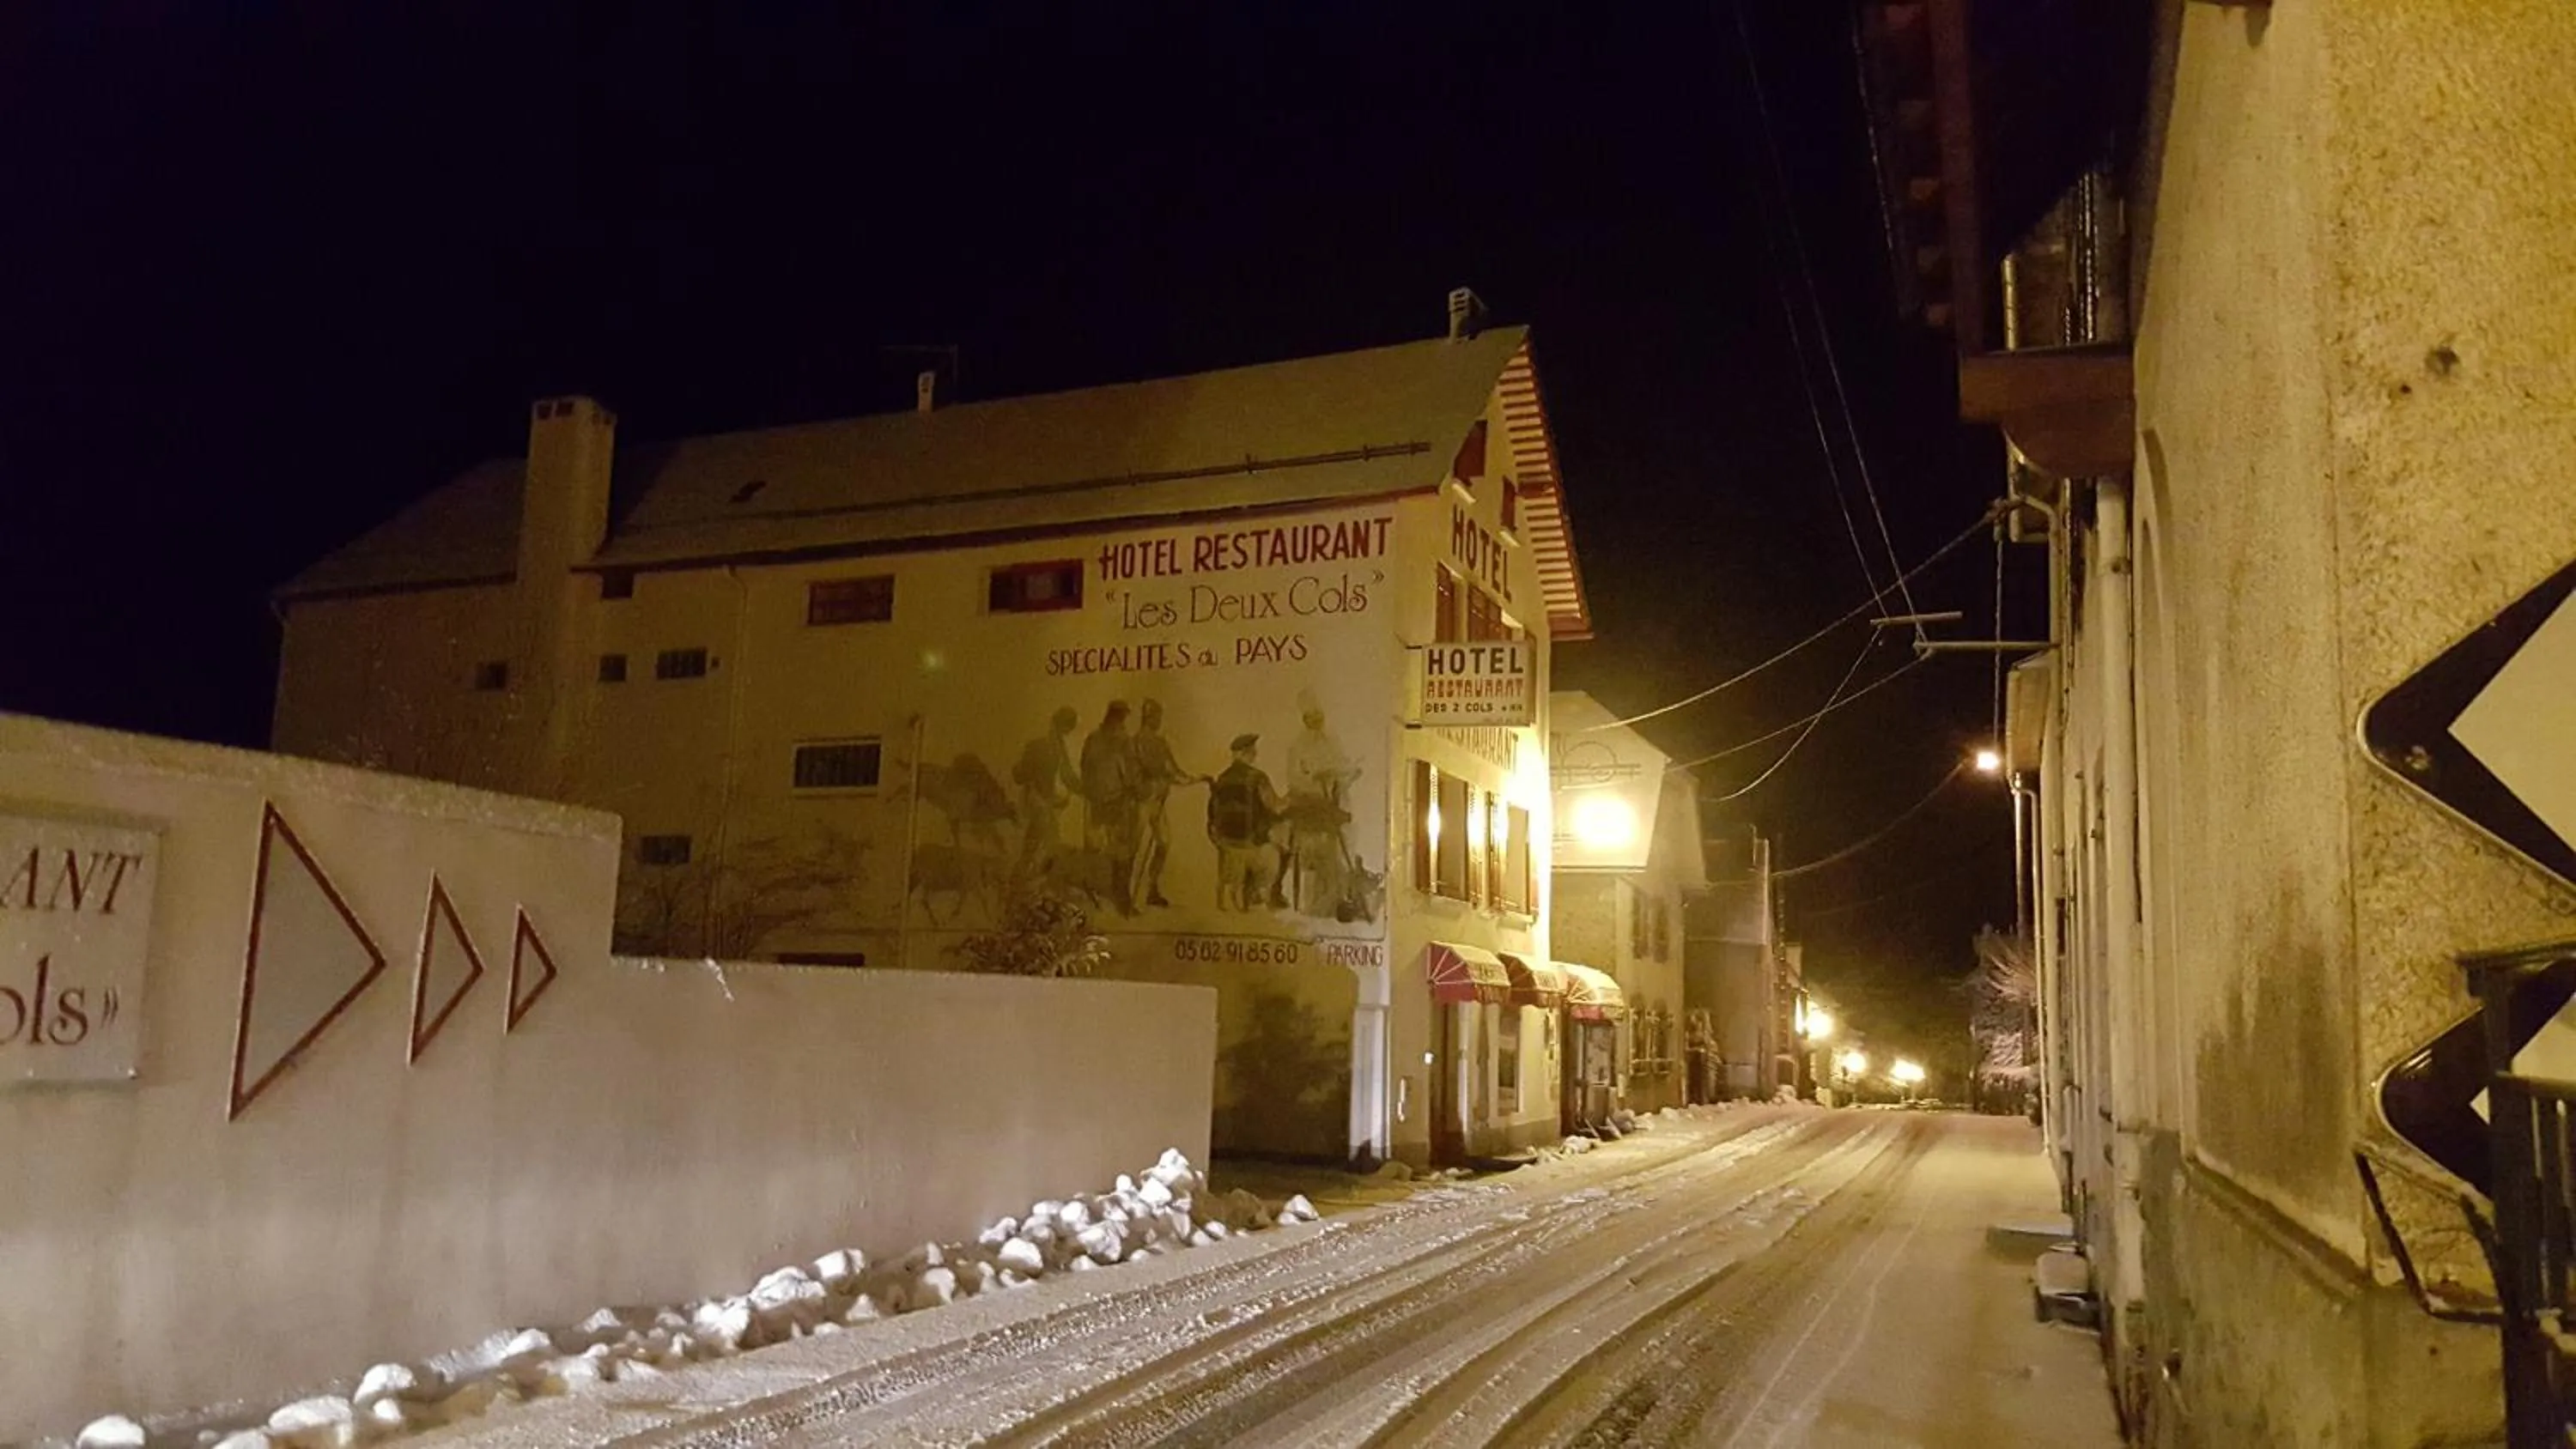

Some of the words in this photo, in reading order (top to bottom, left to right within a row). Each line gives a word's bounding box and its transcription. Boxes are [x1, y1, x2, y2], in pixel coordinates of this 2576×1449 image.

[1098, 538, 1182, 581] HOTEL
[1193, 517, 1393, 573] RESTAURANT
[1451, 504, 1511, 603] HOTEL
[1191, 584, 1280, 623] Deux
[1236, 634, 1308, 664] PAYS
[1428, 647, 1524, 676] HOTEL
[1327, 943, 1383, 967] PARKING
